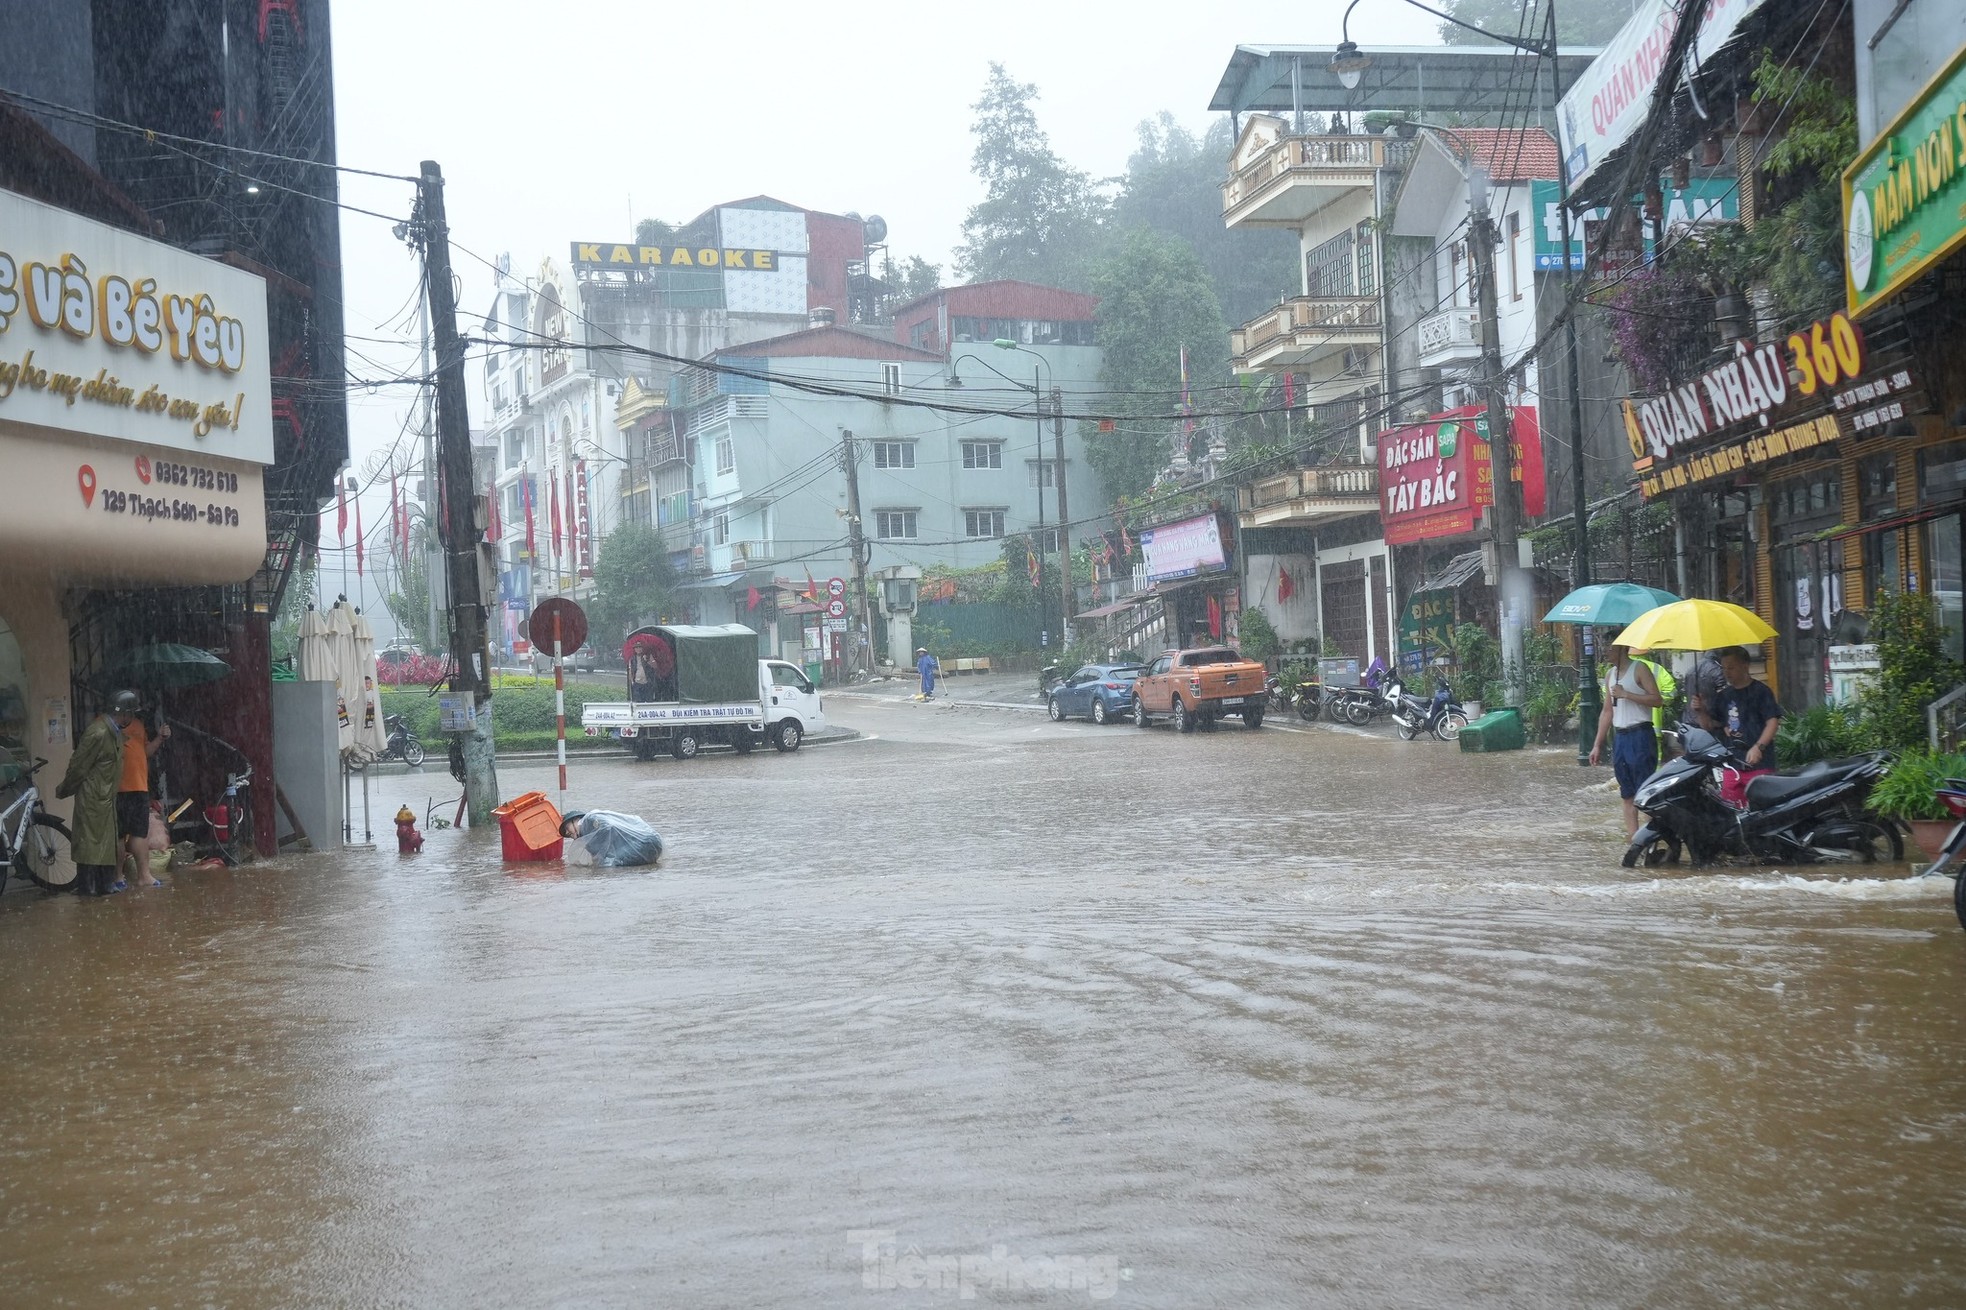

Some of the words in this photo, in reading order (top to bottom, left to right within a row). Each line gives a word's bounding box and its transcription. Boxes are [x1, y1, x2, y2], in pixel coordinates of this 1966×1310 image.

[1591, 64, 1638, 137] QUÁN
[1915, 115, 1955, 206] NON
[578, 244, 773, 269] KARAOKE
[98, 275, 163, 352] Bé
[1702, 340, 1787, 427] NHẬU
[1787, 313, 1860, 395] 360
[1386, 439, 1409, 473] ĐẶC
[1410, 429, 1435, 463] SẢN
[1783, 421, 1820, 452] TRUNG
[155, 461, 188, 486] 0362
[190, 466, 215, 490] 732
[216, 471, 239, 493] 618
[1387, 475, 1419, 514] TÂY
[1420, 458, 1457, 508] BẮC
[102, 488, 127, 513] 129
[129, 493, 171, 522] Thạch
[172, 499, 197, 522] Sơn
[207, 503, 222, 526] Sa
[225, 505, 239, 527] Pa
